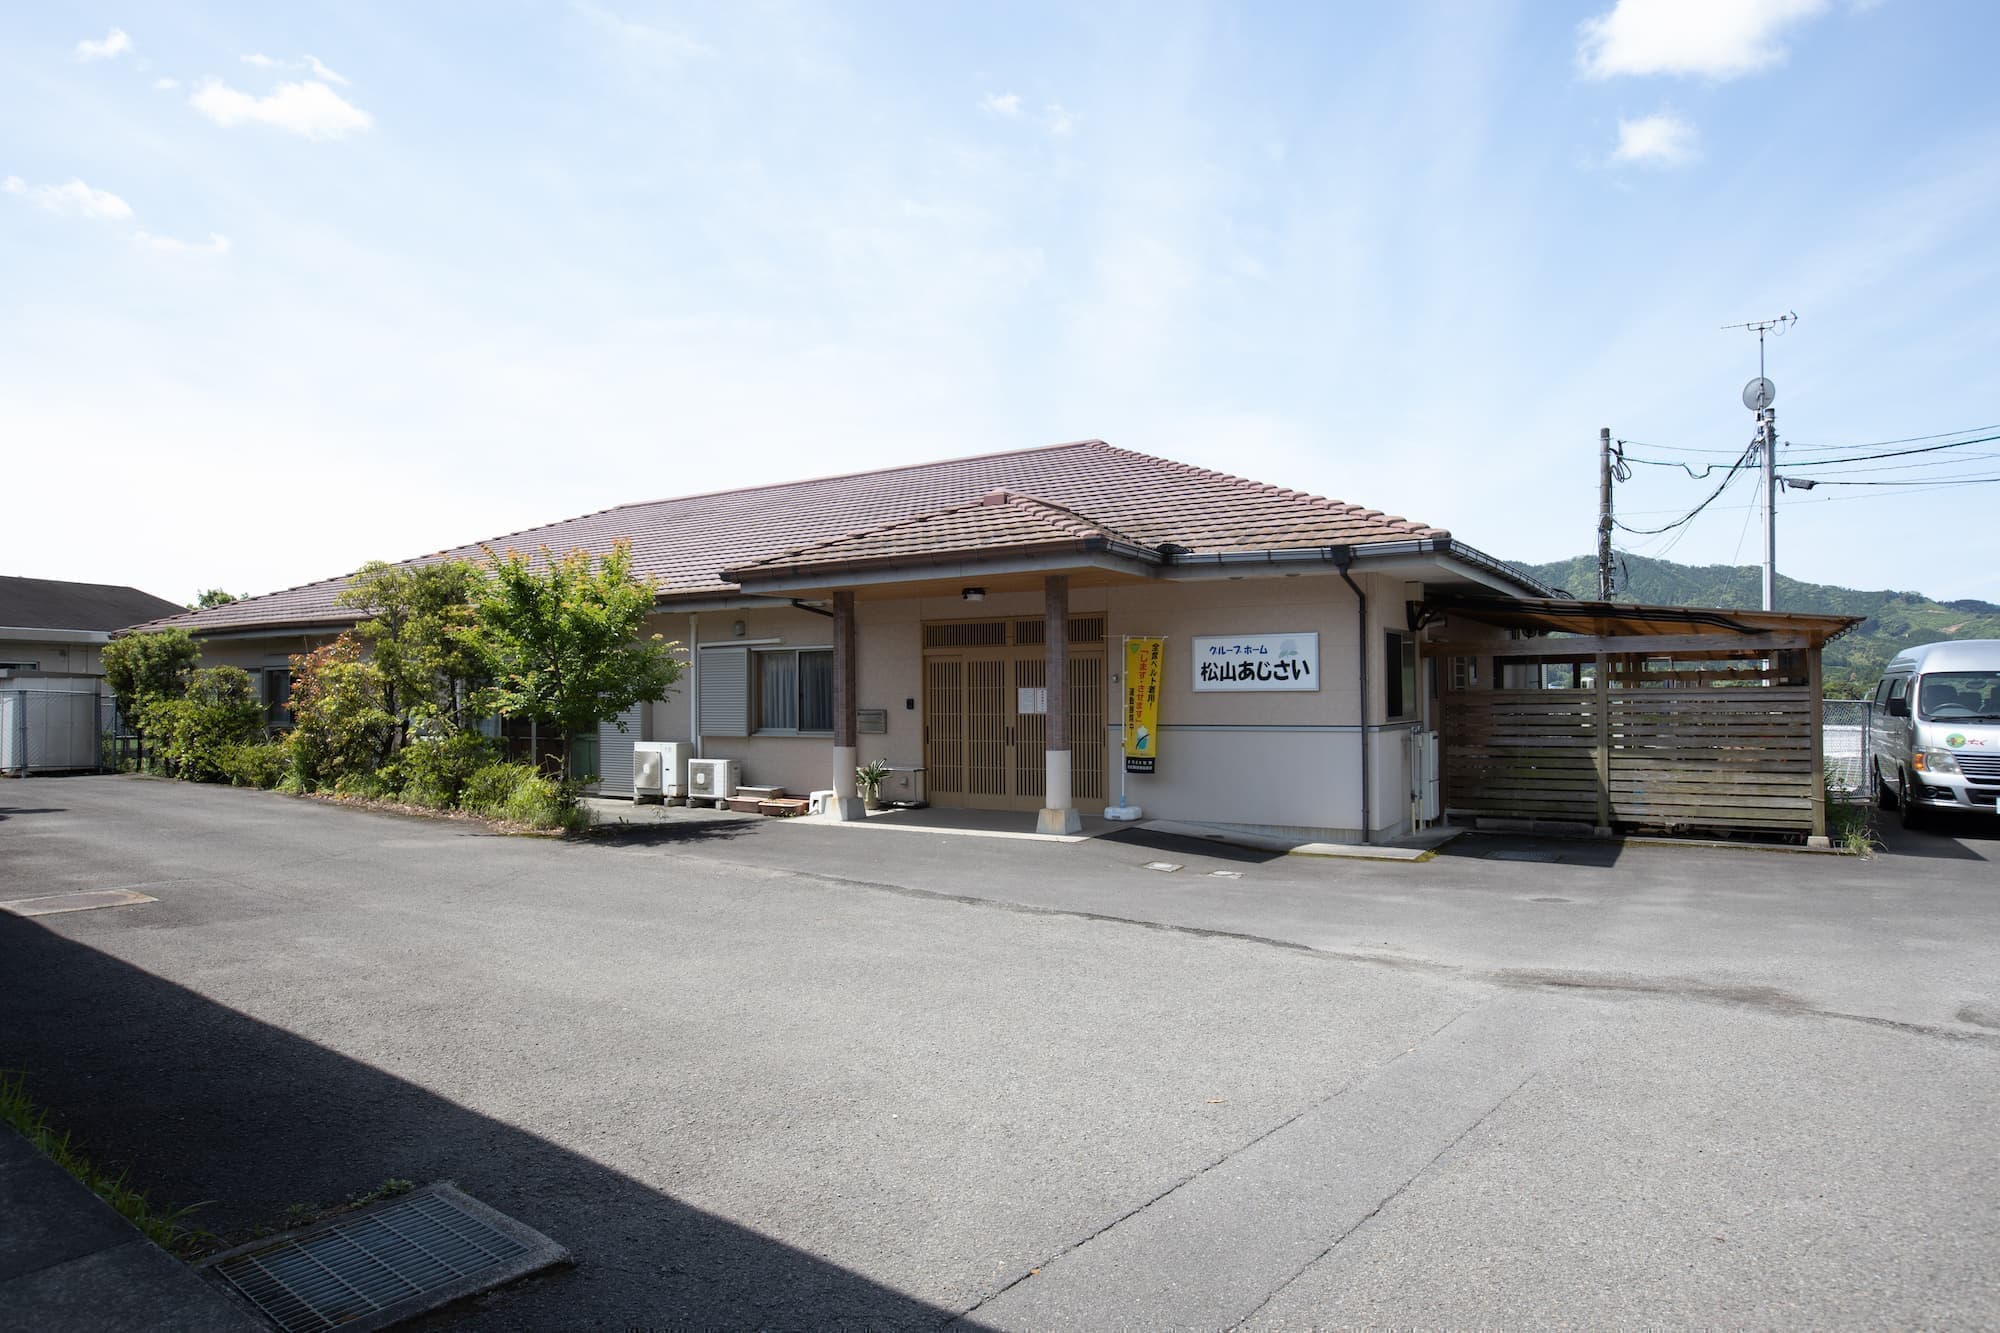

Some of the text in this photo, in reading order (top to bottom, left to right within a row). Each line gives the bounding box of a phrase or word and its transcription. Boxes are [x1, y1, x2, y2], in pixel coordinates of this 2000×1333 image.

[1200, 659, 1310, 681] 松山あじさい
